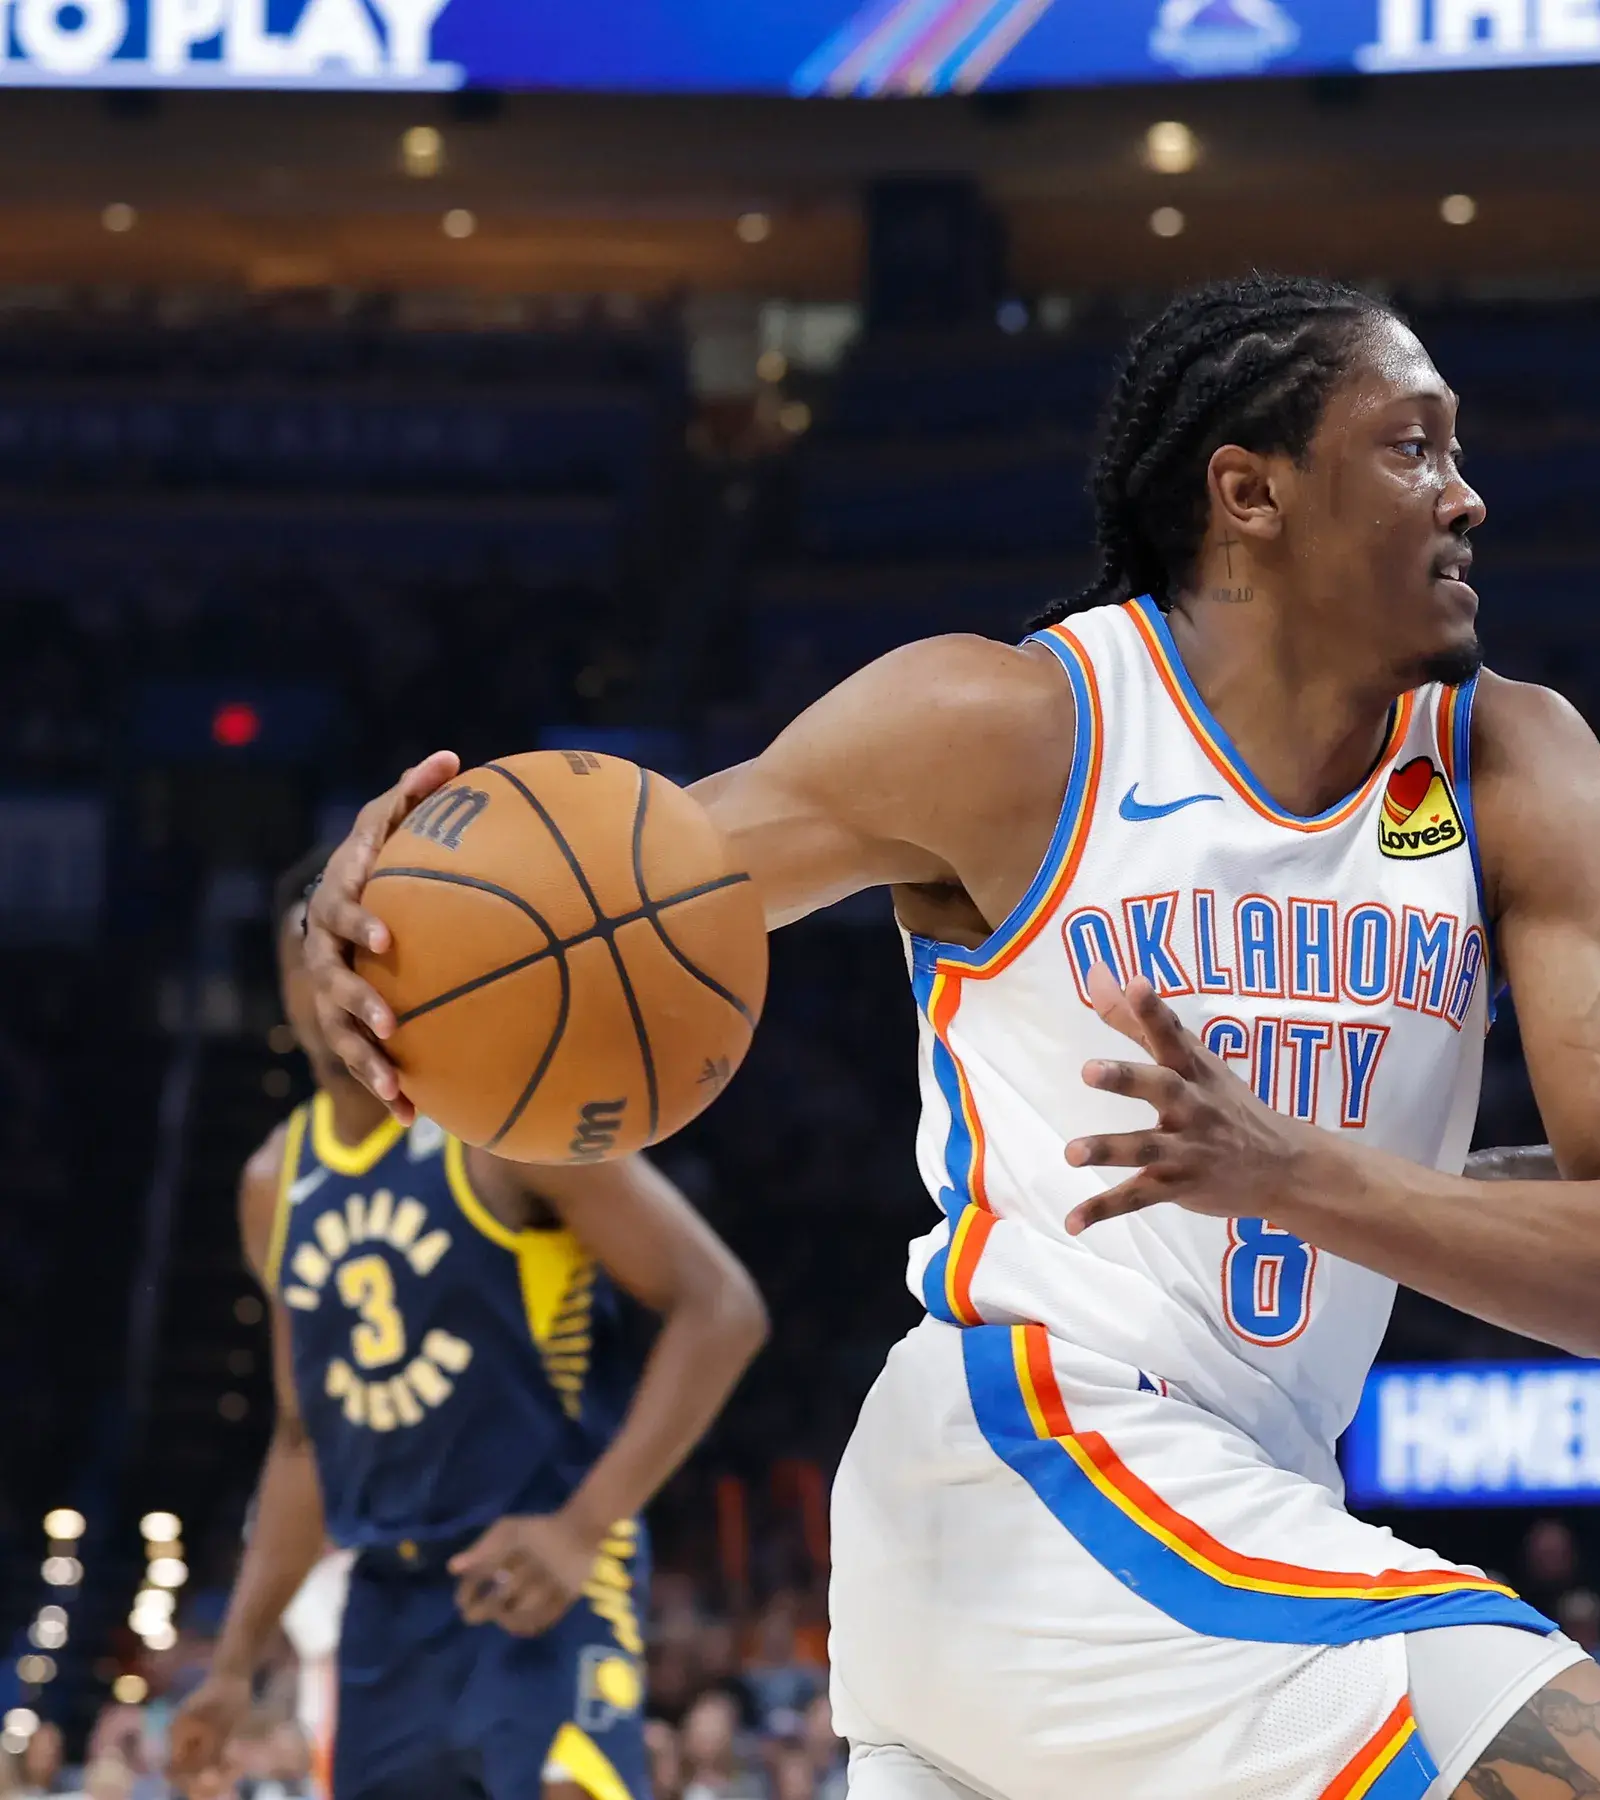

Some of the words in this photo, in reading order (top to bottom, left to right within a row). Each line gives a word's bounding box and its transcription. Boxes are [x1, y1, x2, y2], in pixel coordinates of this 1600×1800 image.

[146, 0, 452, 77] PLAY
[1061, 888, 1488, 1032] OKLAHOMA
[1202, 1015, 1391, 1129] CITY
[283, 1187, 453, 1312] INDIANA
[1220, 1217, 1318, 1348] 8
[335, 1252, 407, 1370] 3
